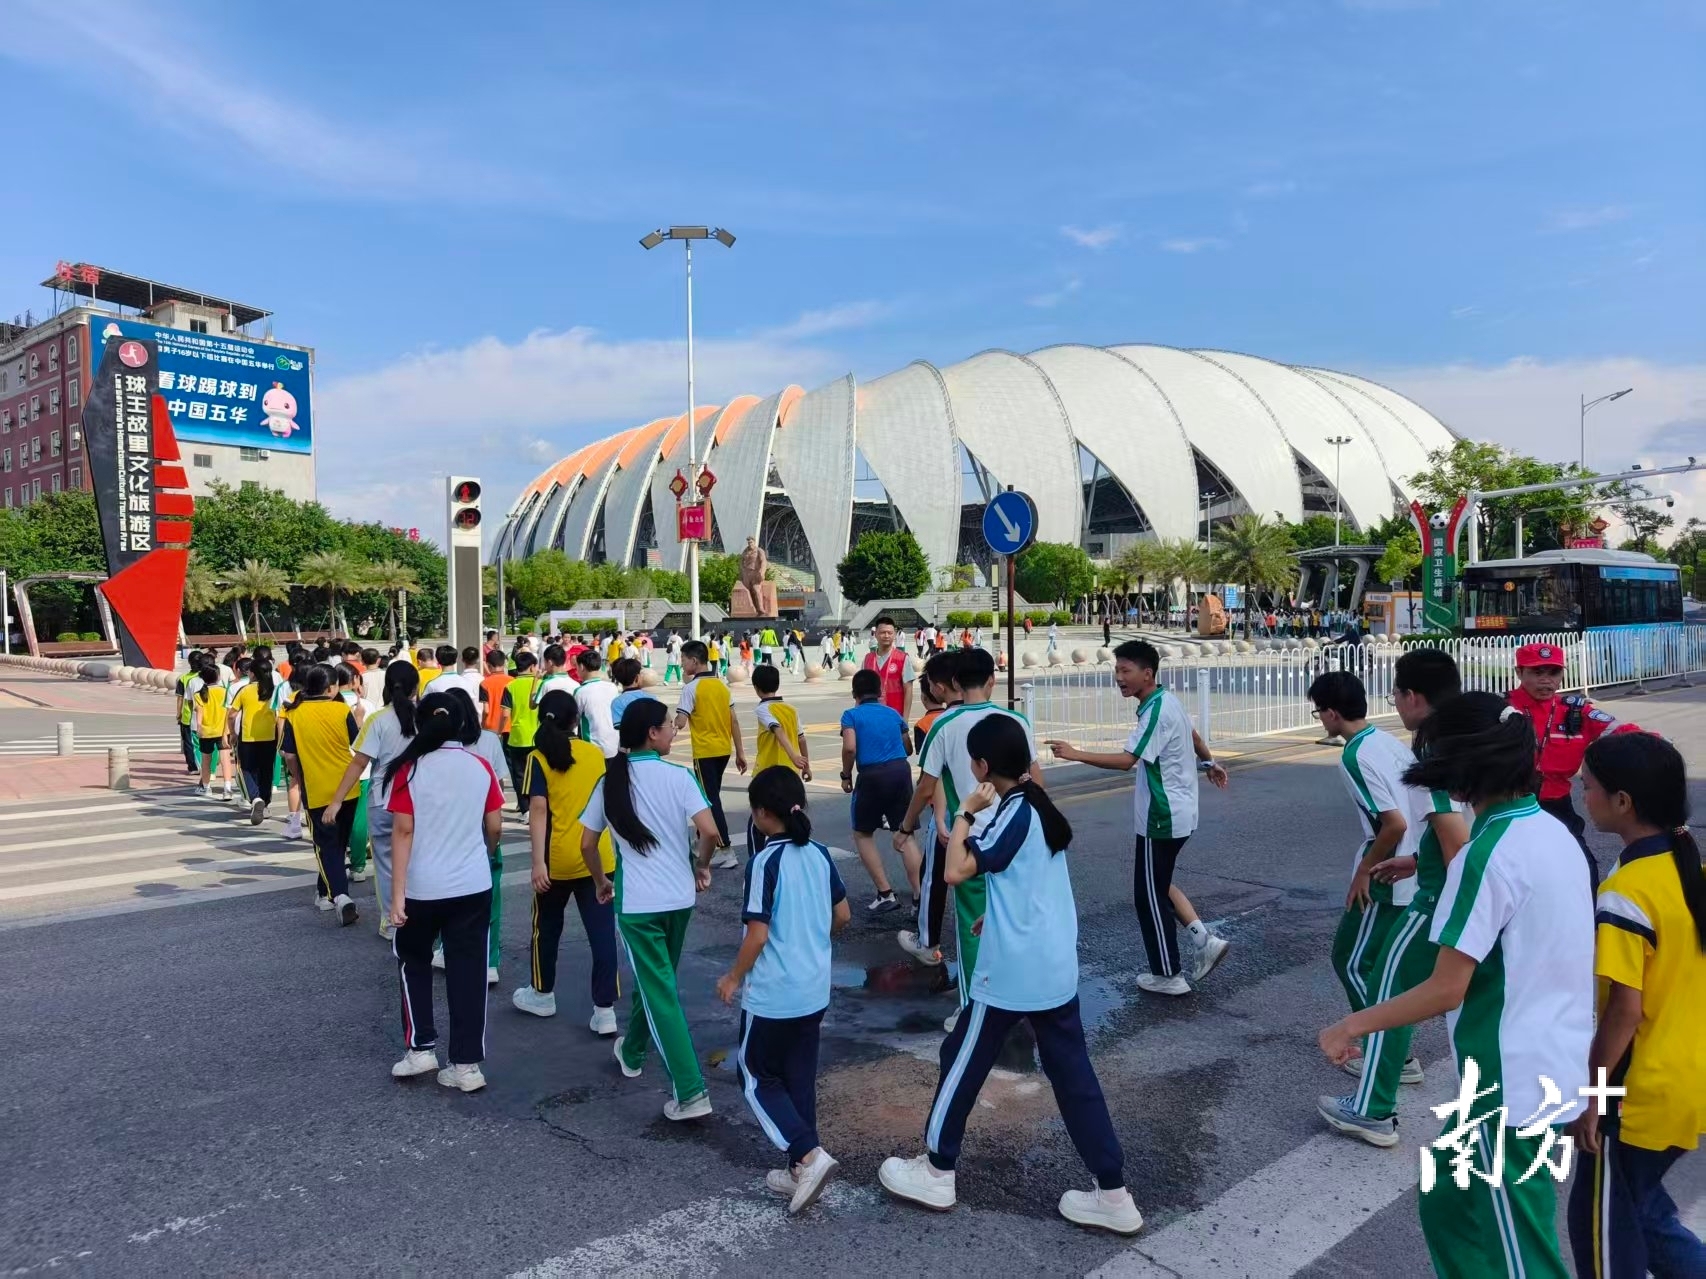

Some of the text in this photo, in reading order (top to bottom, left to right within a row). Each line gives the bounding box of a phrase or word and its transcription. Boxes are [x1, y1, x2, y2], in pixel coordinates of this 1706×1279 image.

[158, 370, 258, 402] 看球踢球到
[167, 398, 248, 425] 中国五华
[125, 375, 151, 551] 球王故里文化旅游区
[1433, 537, 1444, 597] 国家卫生县城
